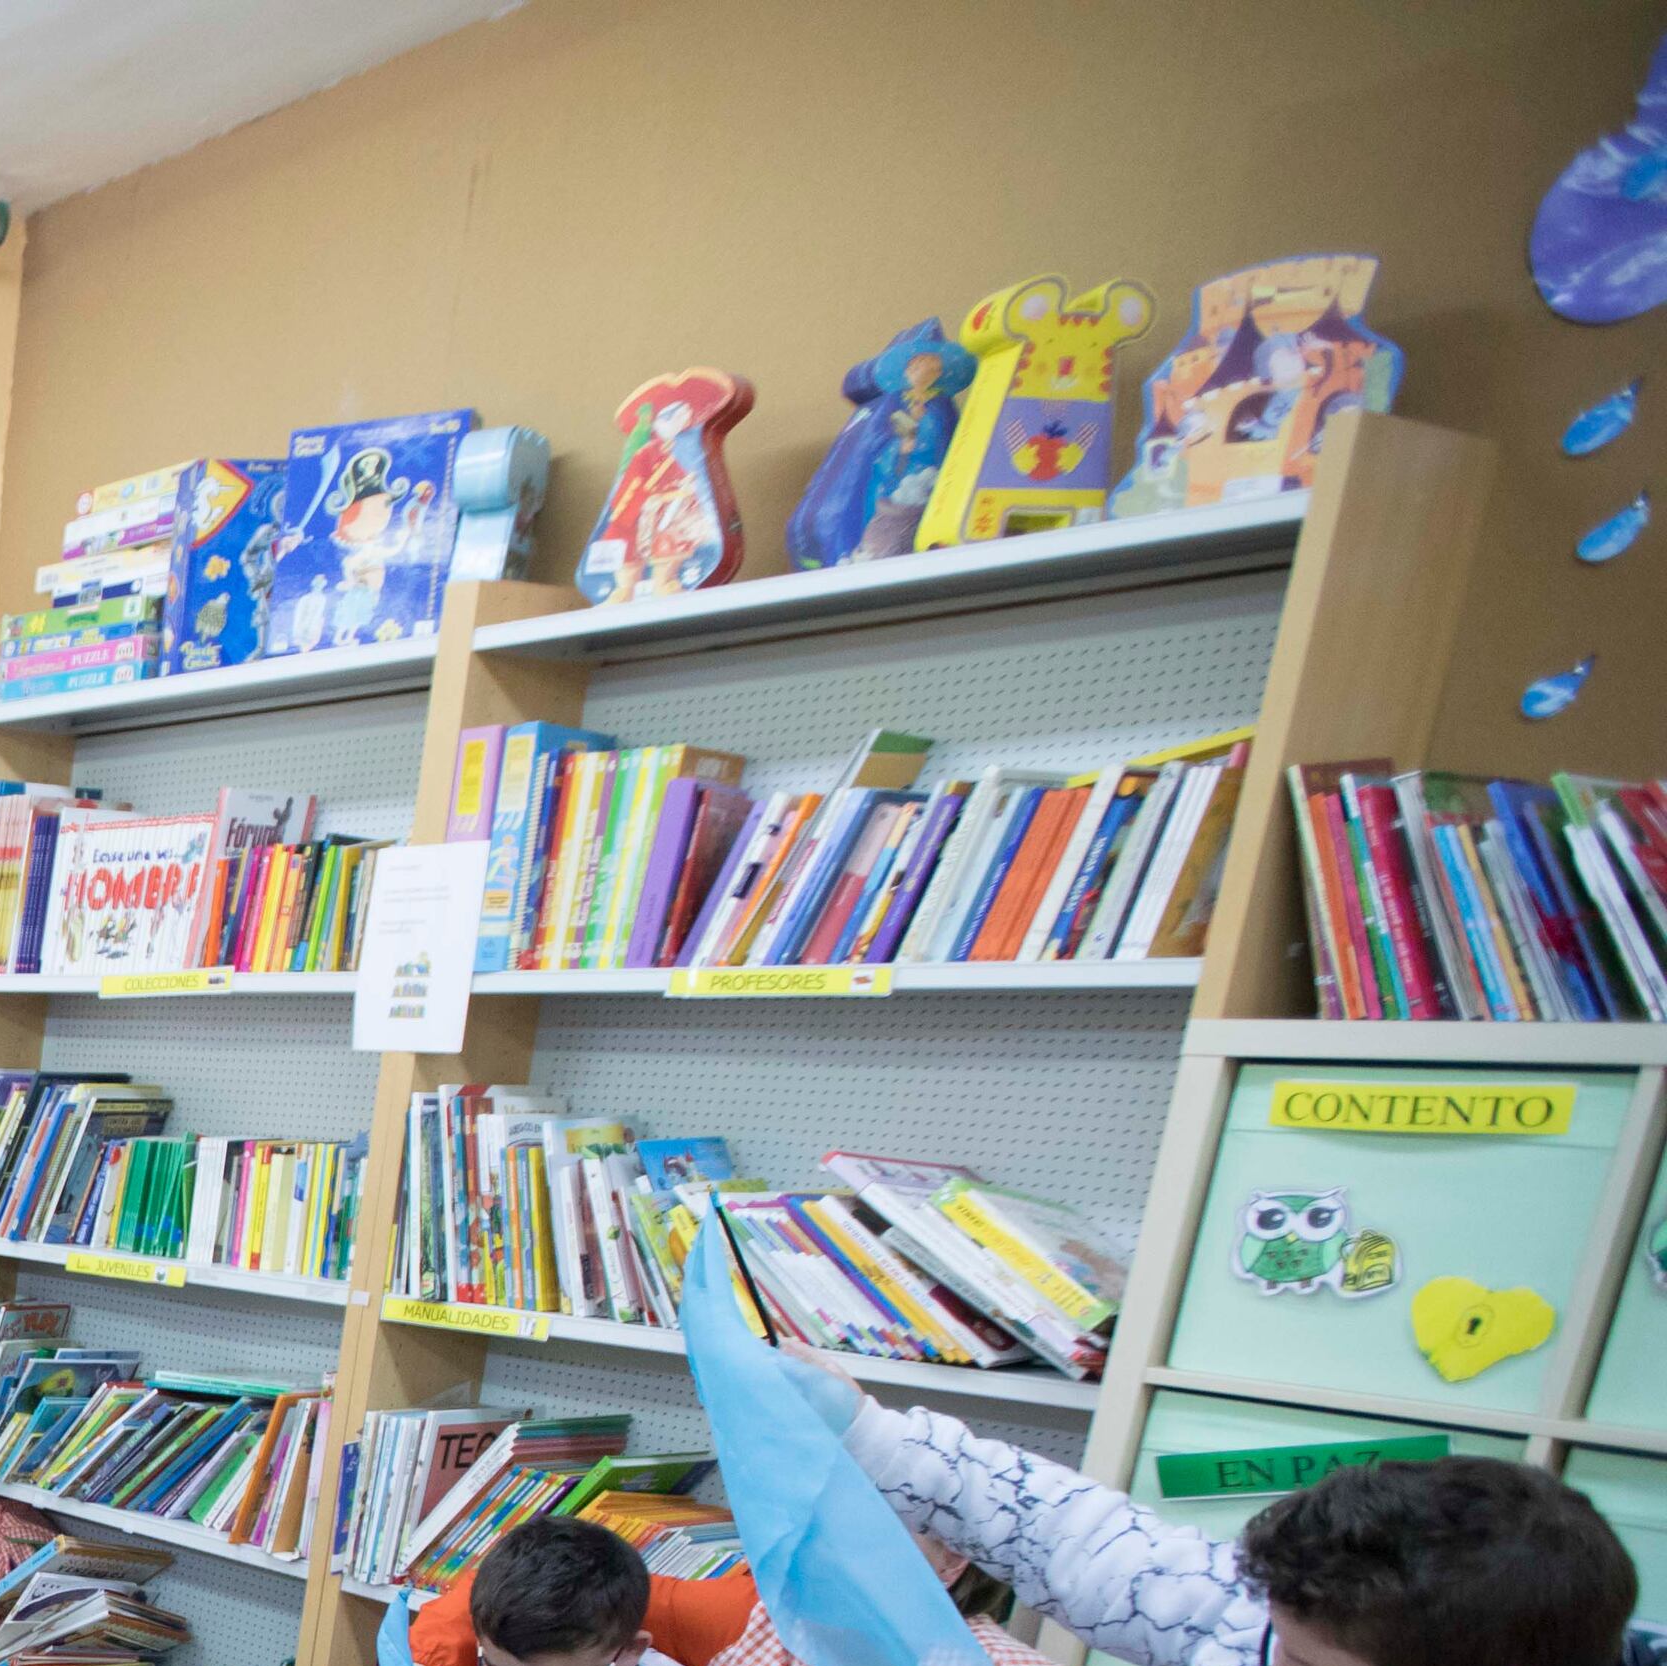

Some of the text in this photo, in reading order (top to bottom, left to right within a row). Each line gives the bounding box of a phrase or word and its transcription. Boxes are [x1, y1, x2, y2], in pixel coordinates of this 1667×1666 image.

[72, 650, 109, 665] PUZZLE
[69, 672, 106, 688] PUZZLE
[64, 862, 200, 911] HOMBRE
[124, 975, 200, 991] COLECCIONES
[710, 973, 827, 990] PROFESORES
[1283, 1091, 1555, 1129] CONTENTO
[95, 1262, 150, 1277] JUVENILES
[404, 1304, 511, 1331] MANUALIDADES
[1217, 1457, 1275, 1489] EN
